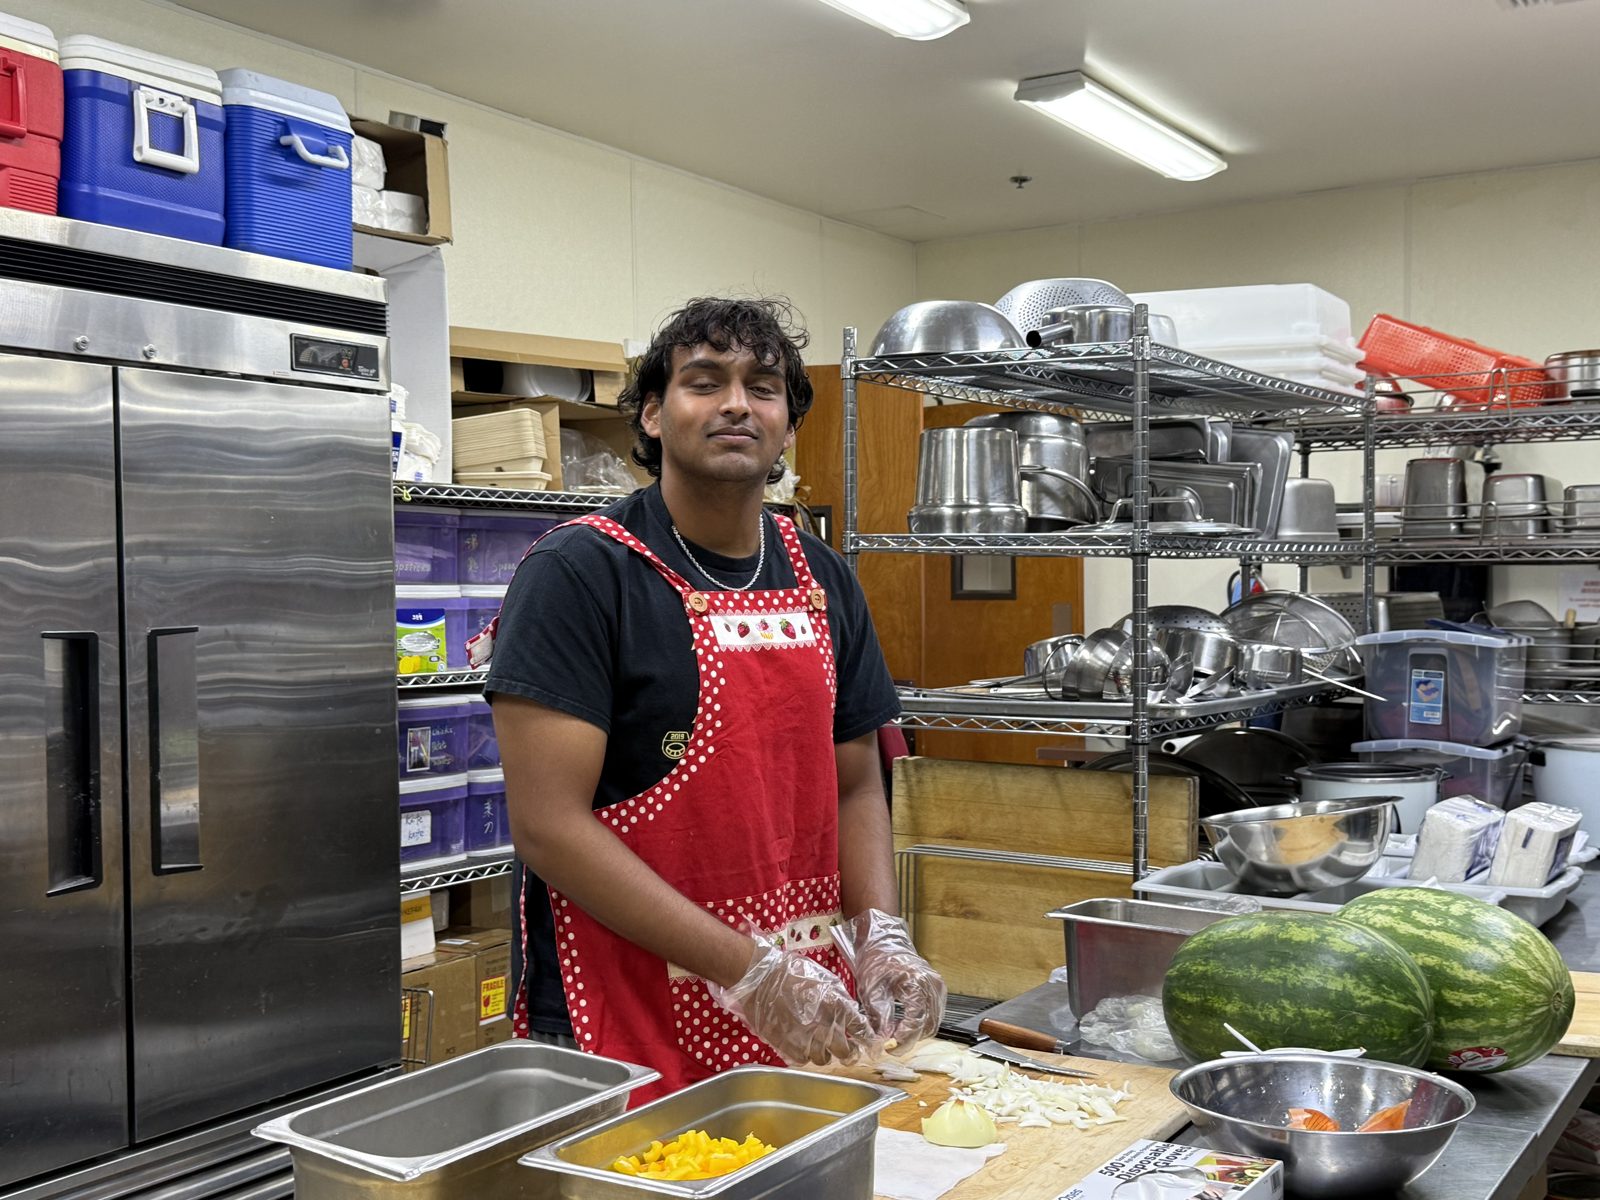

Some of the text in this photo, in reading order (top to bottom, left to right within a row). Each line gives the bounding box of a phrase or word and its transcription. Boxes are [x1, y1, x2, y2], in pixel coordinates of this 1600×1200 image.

[482, 978, 504, 992] FRAGILE
[1115, 1143, 1175, 1181] Disposable
[1153, 1146, 1192, 1167] Gloves
[1098, 1161, 1126, 1177] 500
